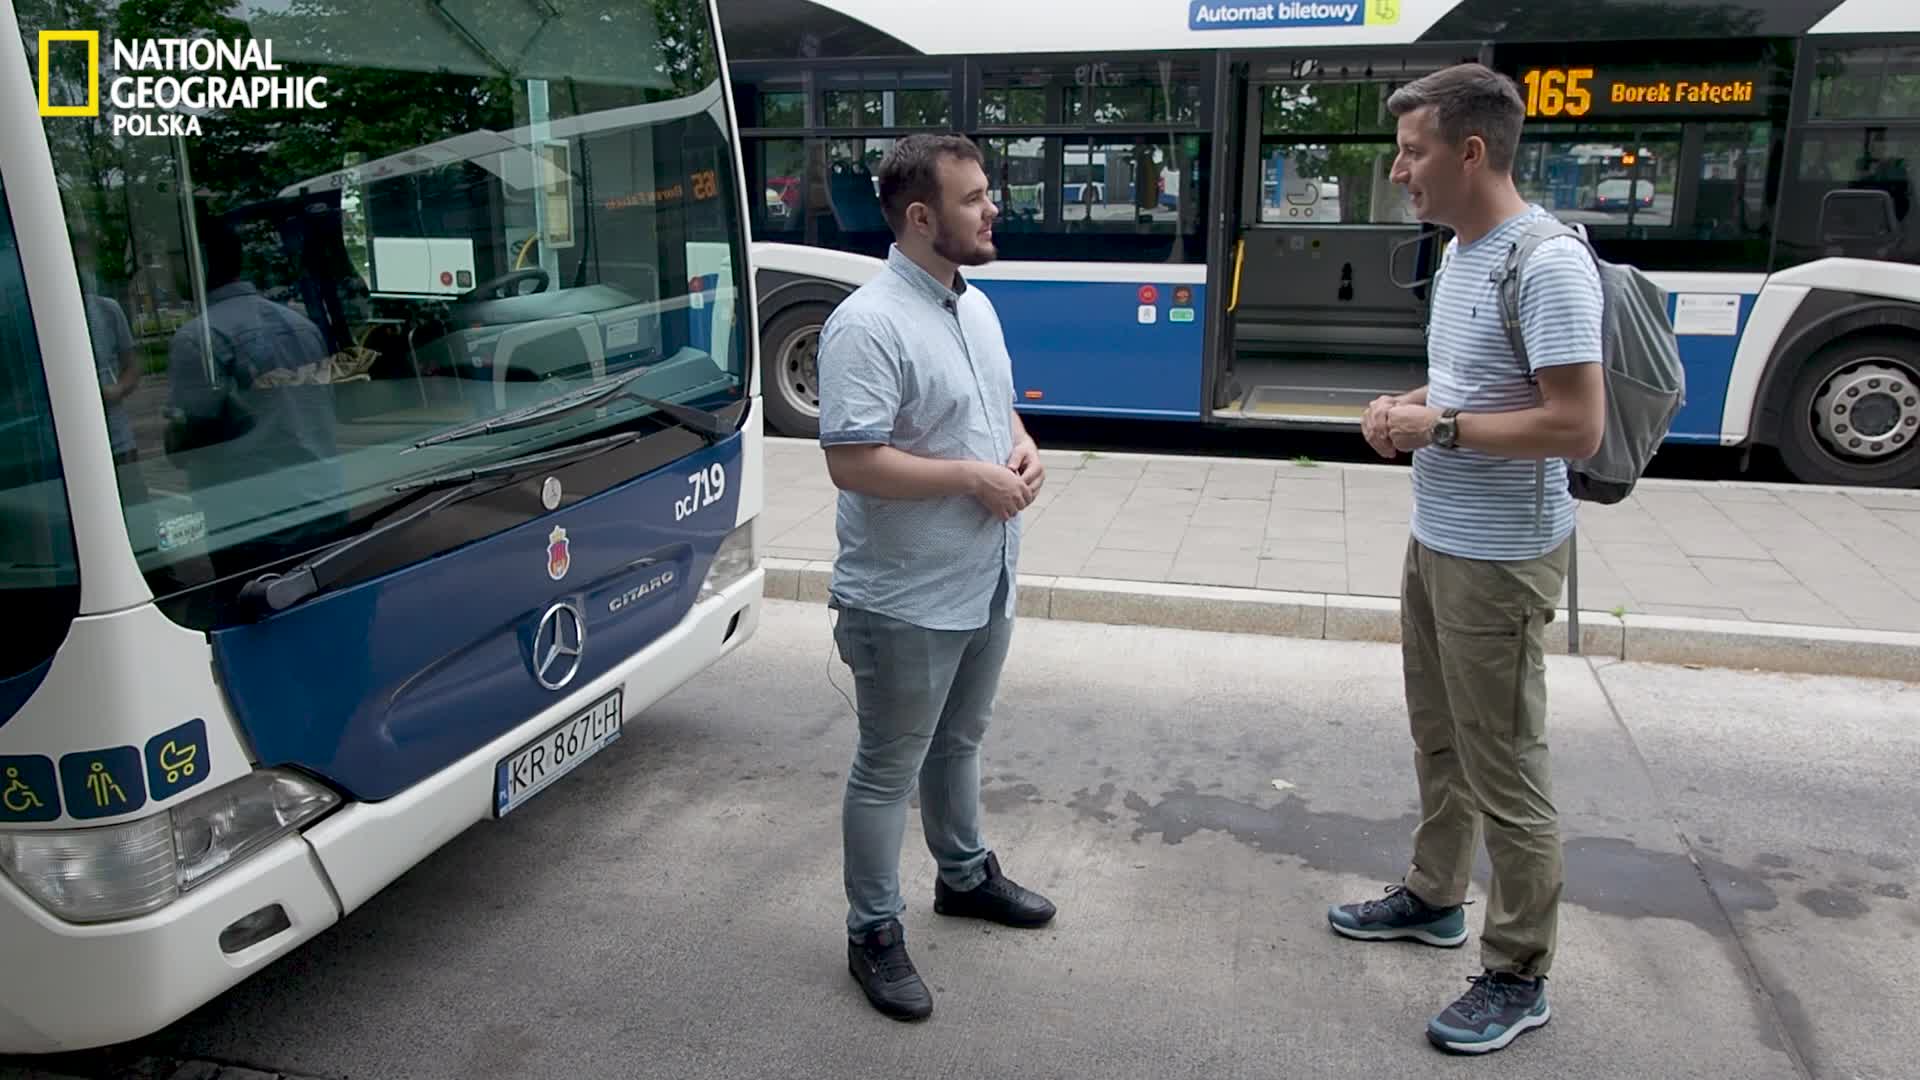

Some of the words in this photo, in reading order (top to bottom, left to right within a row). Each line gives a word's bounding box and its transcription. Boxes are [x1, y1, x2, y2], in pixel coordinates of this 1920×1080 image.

[1195, 4, 1274, 22] Automat
[1278, 1, 1358, 21] biletowy
[1523, 68, 1594, 117] 165
[1611, 82, 1670, 103] Borek
[1674, 81, 1753, 105] Fałęcki
[608, 571, 674, 612] CITARO
[511, 745, 545, 795] KR
[553, 698, 618, 765] 867LH
